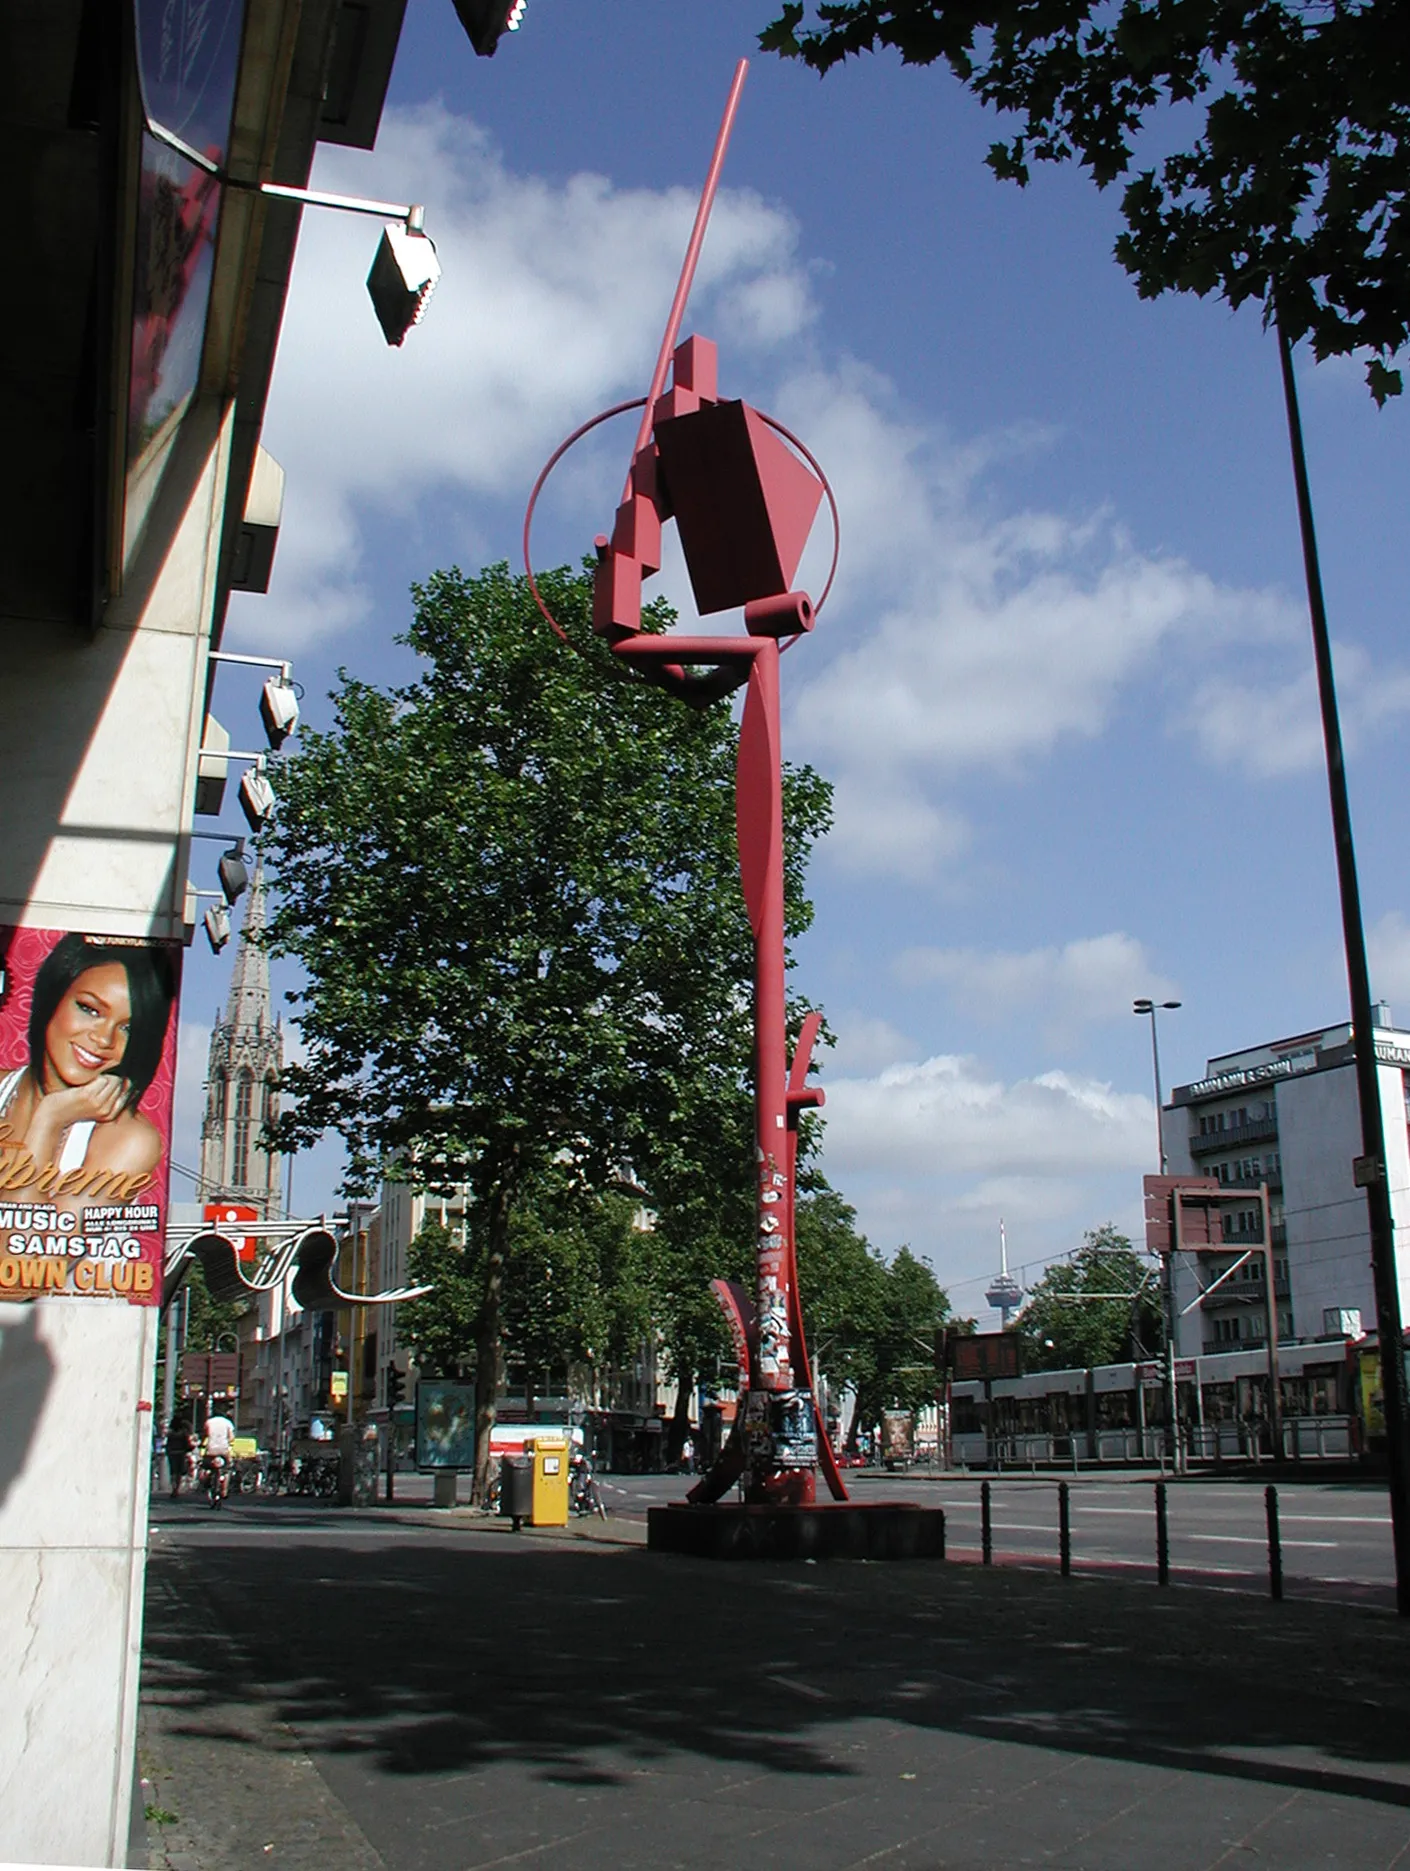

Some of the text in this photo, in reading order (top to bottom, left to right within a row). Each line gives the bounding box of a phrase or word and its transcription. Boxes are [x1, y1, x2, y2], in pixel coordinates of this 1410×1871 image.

[0, 1210, 76, 1231] MUSIC
[84, 1206, 158, 1219] HAPPY HOUR
[8, 1234, 141, 1258] SAMSTAG
[75, 1261, 153, 1291] CLUB
